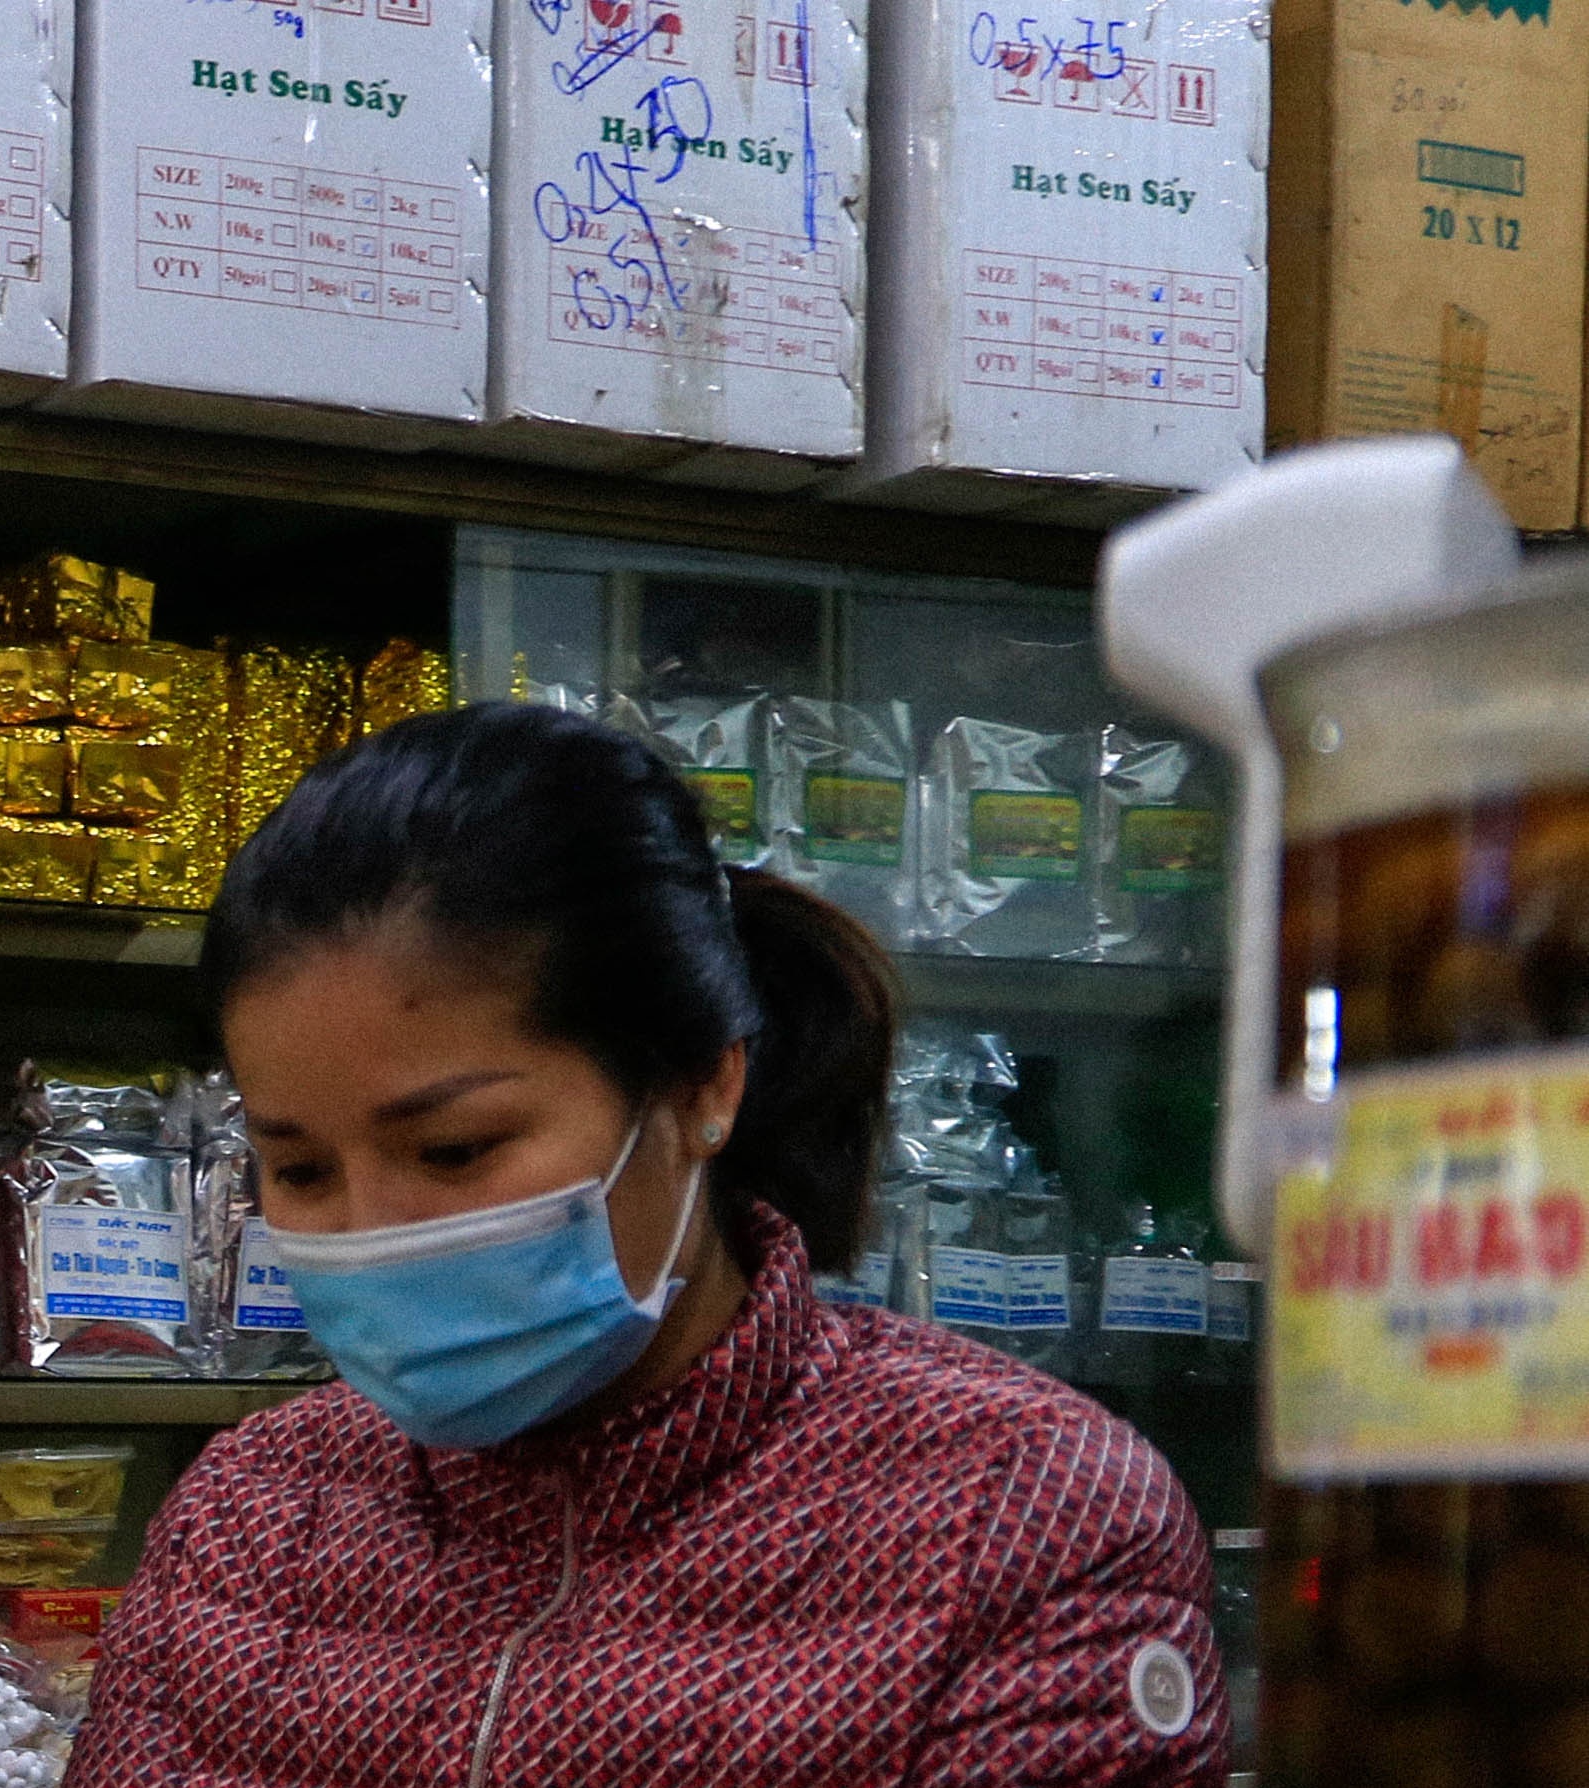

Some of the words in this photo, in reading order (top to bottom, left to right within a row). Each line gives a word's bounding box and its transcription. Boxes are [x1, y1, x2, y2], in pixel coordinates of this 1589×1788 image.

[192, 59, 258, 97] Hạt
[268, 69, 333, 104] Sen
[344, 78, 408, 119] Sấy
[738, 136, 795, 175] Sấy
[153, 164, 202, 186] SIZE
[225, 173, 263, 196] 200g
[308, 183, 345, 206] 500g
[389, 195, 419, 218] 2kg
[1011, 164, 1068, 199] Hạt
[1077, 172, 1132, 202] Sen
[1142, 177, 1197, 214] Sấy
[154, 211, 195, 231] N.W
[225, 220, 263, 242] 10kg
[309, 231, 347, 251] 10kg
[390, 242, 428, 263] 10kg
[1422, 206, 1455, 240] 20
[1495, 215, 1521, 251] 12
[153, 256, 202, 279] Q'TY
[977, 265, 1018, 286] SIZE
